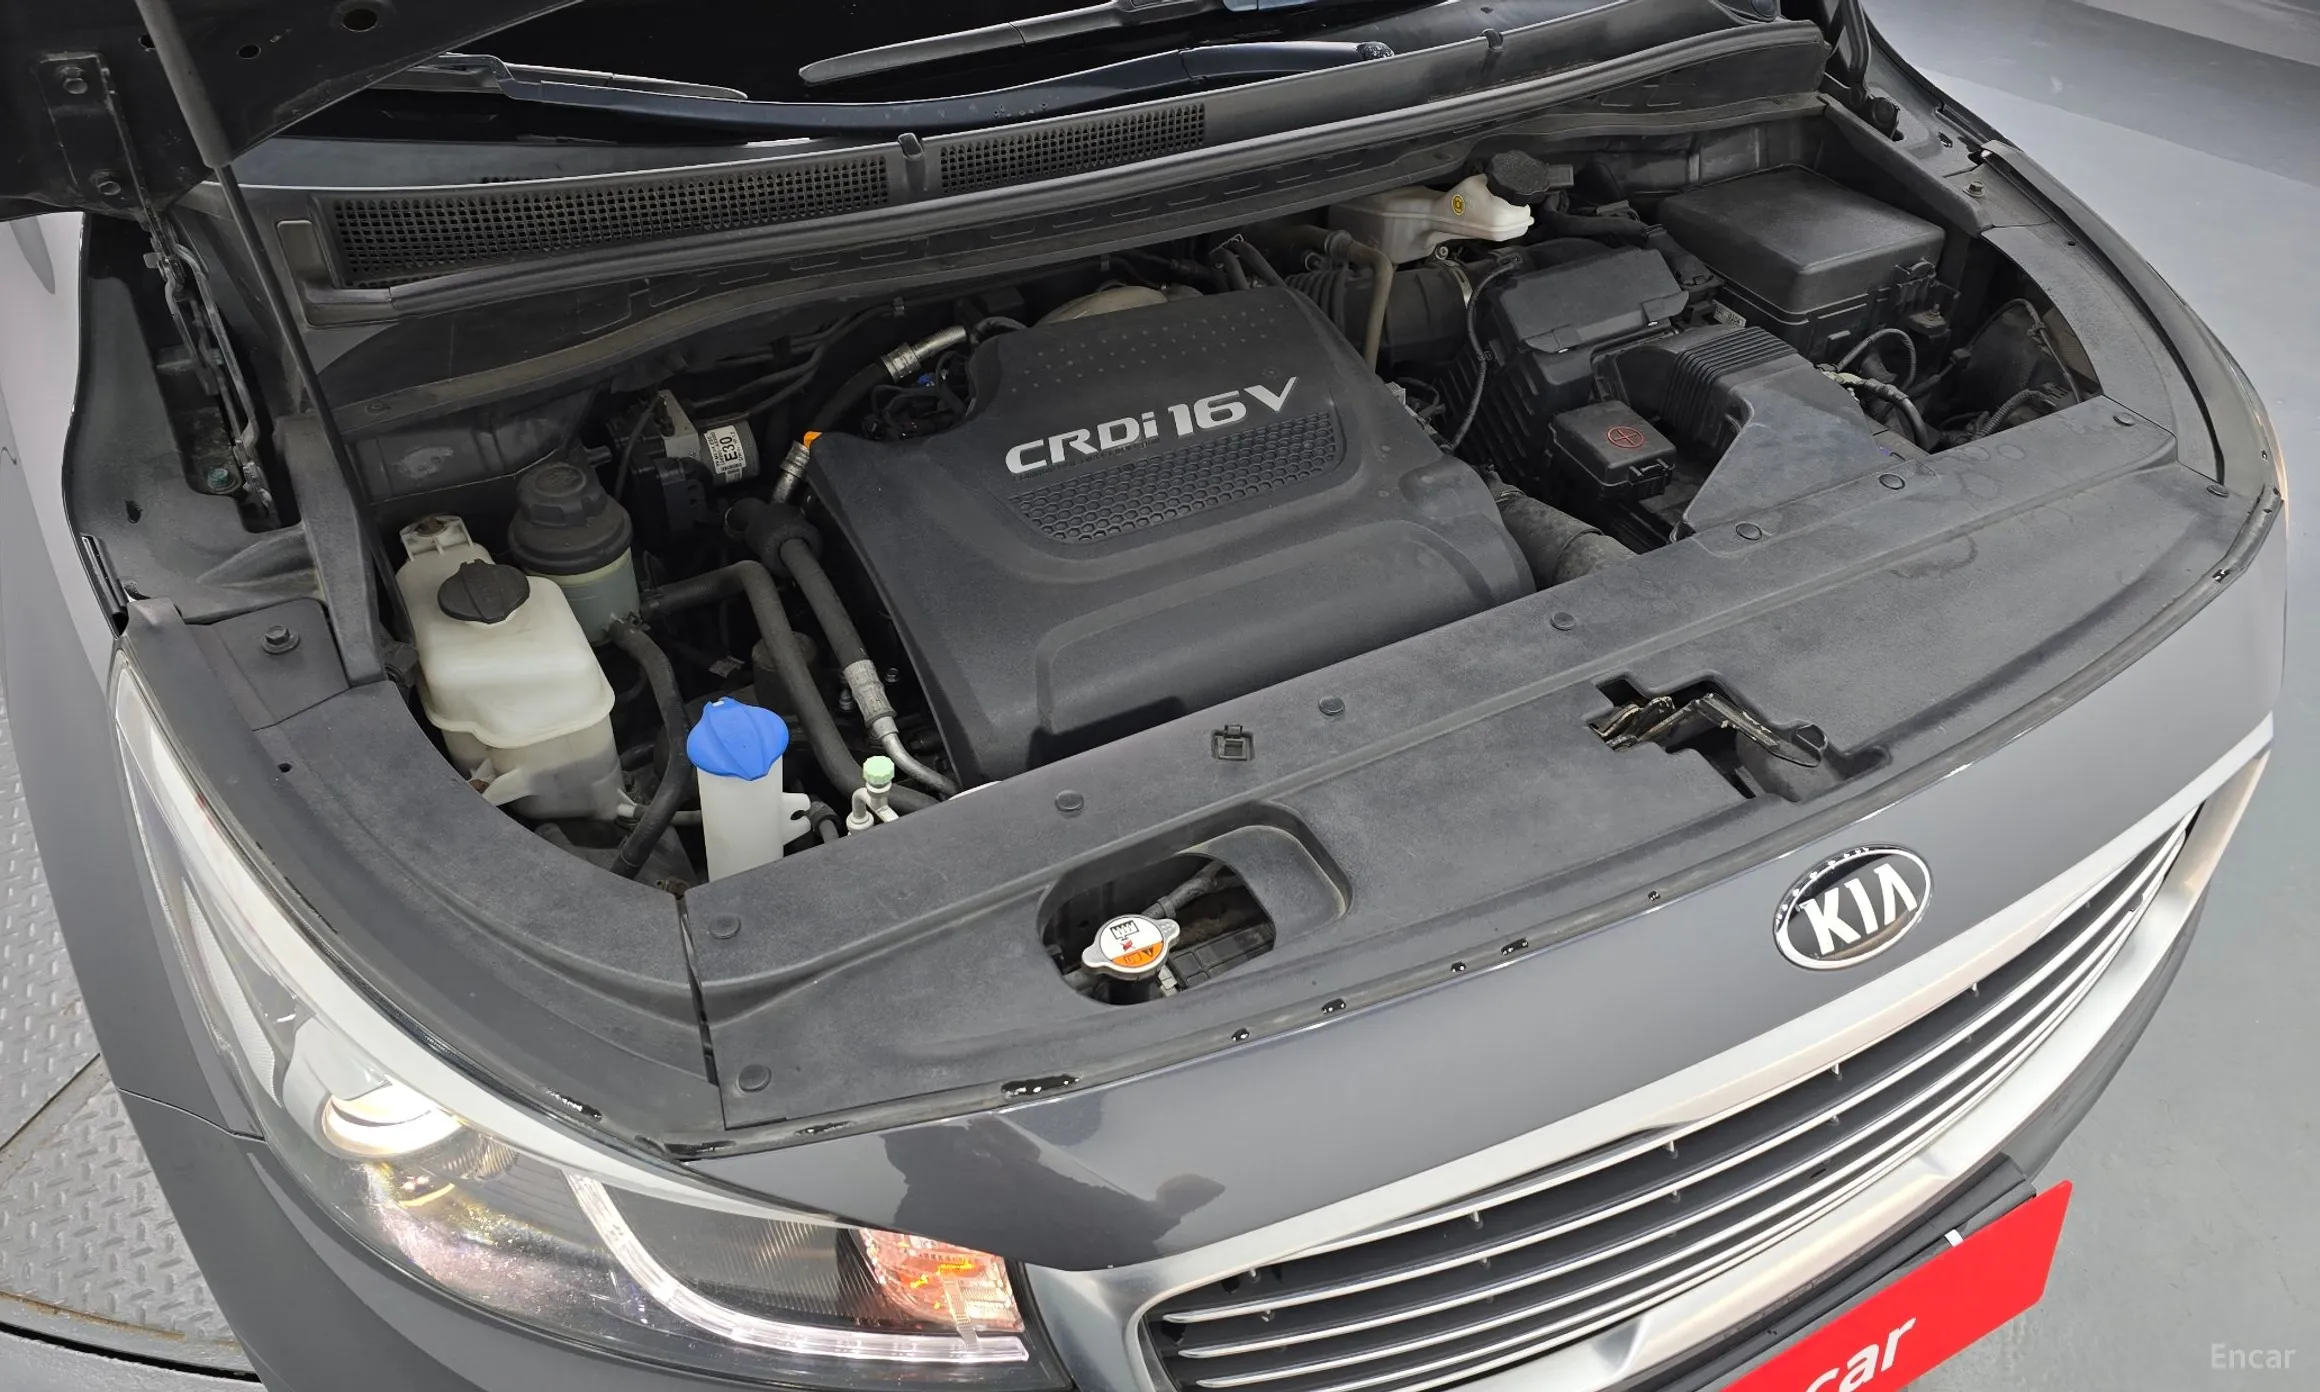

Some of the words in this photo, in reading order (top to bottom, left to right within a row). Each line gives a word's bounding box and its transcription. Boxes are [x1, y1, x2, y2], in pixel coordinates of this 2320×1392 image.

[720, 437, 738, 461] E30
[1005, 411, 1159, 474] CRDi
[1167, 376, 1298, 436] 16V
[1799, 863, 1918, 955] KIA
